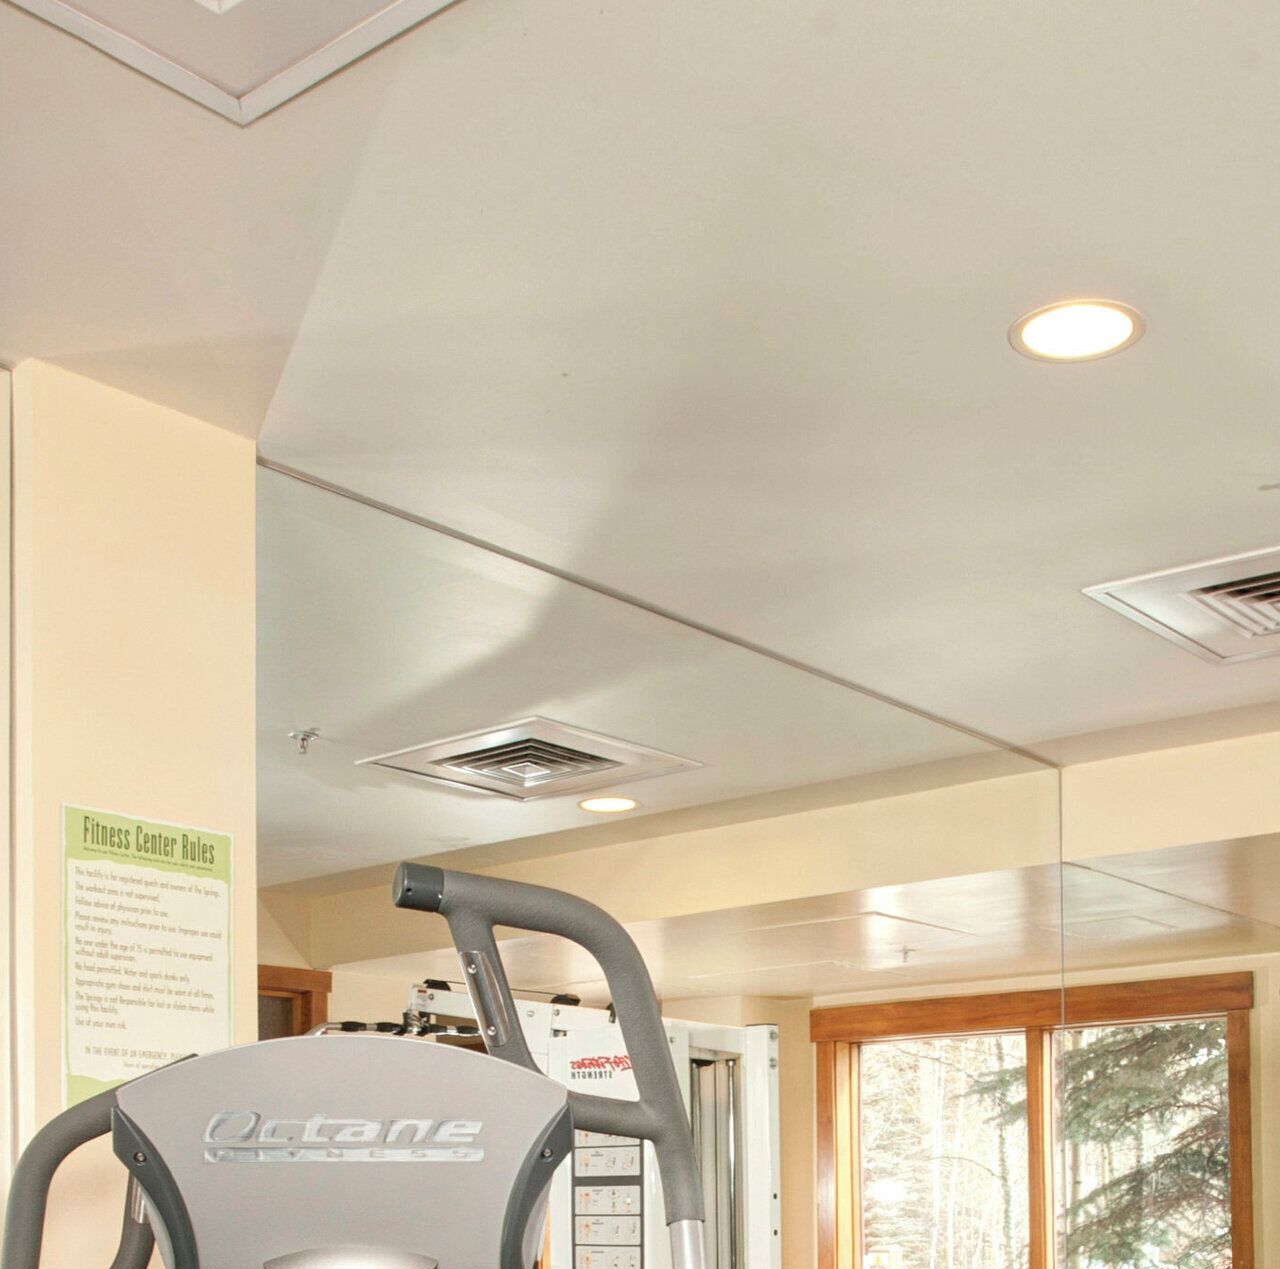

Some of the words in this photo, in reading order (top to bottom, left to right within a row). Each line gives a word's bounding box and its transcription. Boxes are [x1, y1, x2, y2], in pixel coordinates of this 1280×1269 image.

[83, 816, 130, 851] Fitness
[136, 825, 177, 858] Center
[182, 834, 215, 865] Rules
[92, 1046, 103, 1056] THE
[104, 1047, 120, 1057] EVENT
[202, 1110, 483, 1143] Octane
